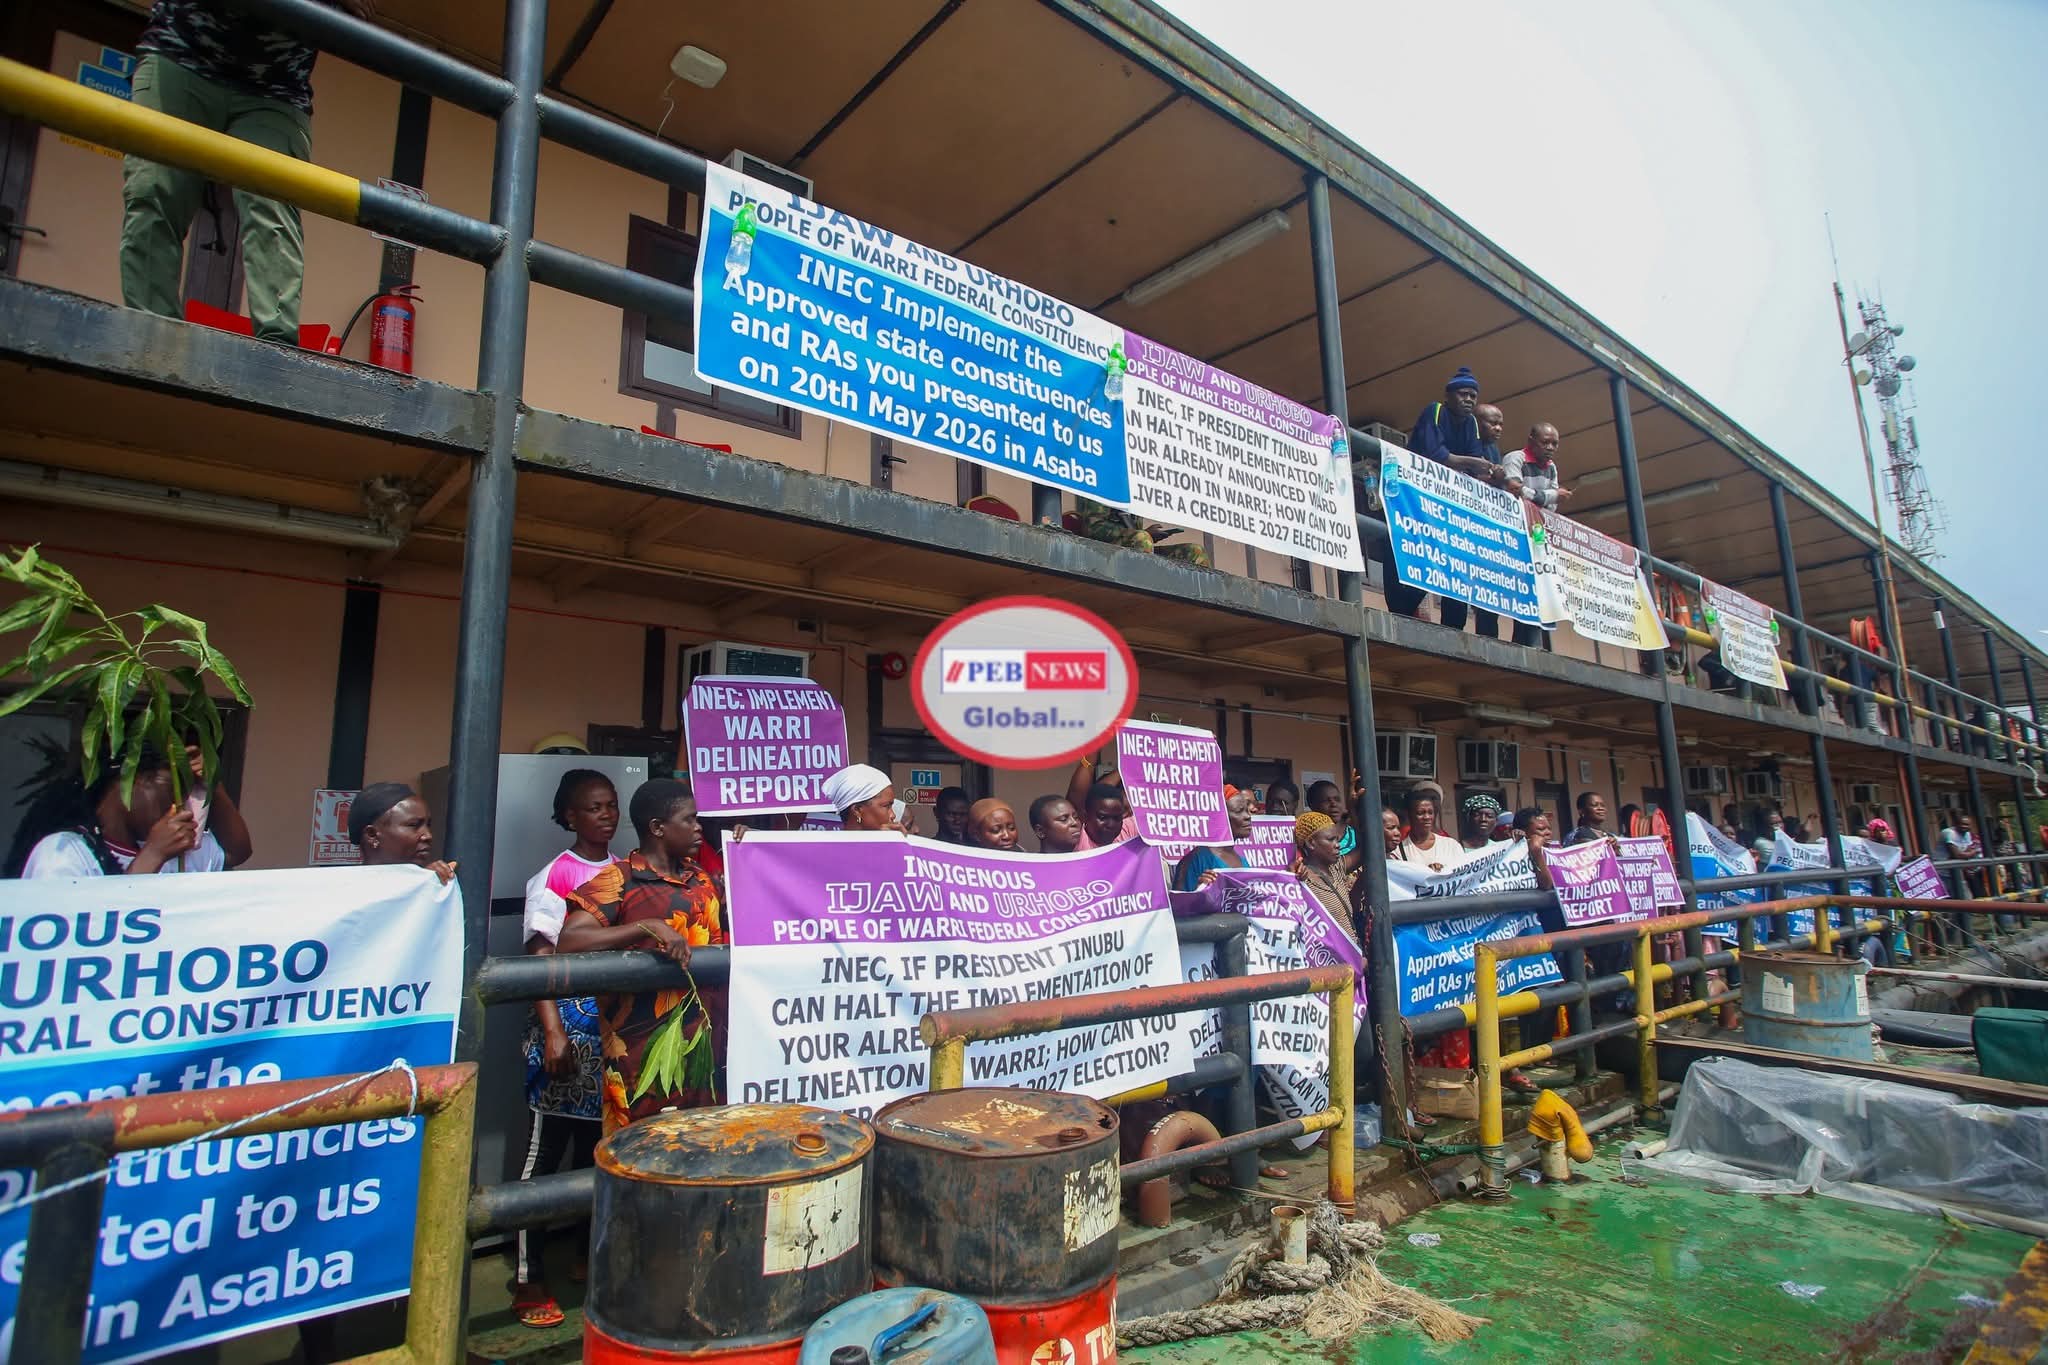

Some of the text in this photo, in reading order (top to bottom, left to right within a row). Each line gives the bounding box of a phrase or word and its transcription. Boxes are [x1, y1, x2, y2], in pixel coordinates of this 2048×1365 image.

[84, 76, 132, 100] Senior
[817, 226, 845, 250] OF
[851, 238, 919, 281] WARRI
[924, 268, 997, 315] FEDERAL
[905, 242, 957, 272] AND
[965, 263, 1075, 327] URHOBO
[796, 253, 1063, 377] INEC Implement the
[723, 270, 1112, 430] Approved state constituencies
[730, 310, 1105, 457] and RAs you presented to us
[1141, 340, 1313, 428] IJAW AND URHOBO
[1161, 373, 1177, 389] OF
[1178, 377, 1219, 407] WARRI
[1221, 394, 1267, 425] FEDERAL
[738, 354, 1099, 488] on 20th May 2026 in Asaba
[1137, 387, 1318, 467] INEC, IF PRESIDENT TINUBU
[1146, 414, 1335, 496] HALT THE IMPLEMENTATION OF
[1162, 443, 1224, 479] ALREADY
[1227, 466, 1306, 504] ANNOUNCED
[1308, 490, 1337, 515] WARD
[1410, 452, 1521, 515] IJAW AND URHOBO
[1421, 477, 1490, 519] OF WARRI FEDERAL
[1177, 496, 1348, 560] A CREDIBLE 2027 ELECTION?
[1204, 480, 1352, 541] IN WARRI; HOW CAN YOU
[1395, 510, 1449, 545] Approved
[1449, 533, 1477, 554] state
[1419, 495, 1519, 551] INEC Implement the
[1552, 534, 1561, 547] OF
[1575, 529, 1589, 544] AND
[1401, 538, 1424, 558] and
[1427, 545, 1447, 567] RAs
[1449, 555, 1467, 575] you
[1469, 562, 1516, 591] presented
[1517, 578, 1530, 595] to
[1407, 566, 1422, 581] on
[1425, 567, 1450, 591] 20th
[1451, 578, 1473, 602] May
[1474, 585, 1499, 606] 2026
[1500, 593, 1510, 609] in
[1593, 564, 1606, 583] The
[1599, 621, 1642, 645] Constituency
[691, 684, 837, 711] INEC: IMPLEMENT
[723, 715, 811, 741] WARRI
[1122, 732, 1218, 763] INEC: IMPLEMENT
[695, 743, 841, 773] DELINEATION
[918, 771, 934, 785] 01
[1142, 762, 1201, 786] WARRI
[719, 773, 824, 806] REPORT
[1127, 786, 1221, 812] DELINEATION
[1146, 812, 1210, 838] REPORT
[319, 843, 361, 853] FIRE
[1243, 847, 1289, 867] WARRI
[903, 855, 1036, 890] INDIGENOUS
[773, 891, 1153, 942] PEOPLE OF WARRI FEDERAL CONSTITUENCY
[826, 879, 1113, 919] IJAW AND URHOBO
[1564, 897, 1614, 920] REPORT
[821, 929, 1125, 988] INEC, IF PRESIDENT TINUBU
[1262, 928, 1283, 948] IF
[2, 938, 329, 1009] URHOBO
[772, 995, 826, 1026] CAN
[833, 992, 903, 1021] HALT
[909, 989, 960, 1016] THE
[1133, 953, 1153, 976] OF
[1411, 972, 1462, 1004] and RAs
[1506, 968, 1517, 988] in
[108, 980, 432, 1045] CONSTITUENCY
[744, 1062, 925, 1105] DELINEATION
[970, 1044, 1052, 1082] WARRI;
[1056, 1028, 1098, 1062] HOW
[1101, 1021, 1134, 1047] CAN
[1139, 1014, 1176, 1038] YOU
[779, 1027, 931, 1066] YOUR ALRE
[1257, 1029, 1270, 1050] A
[1073, 1041, 1170, 1087] ELECTION?
[1287, 1069, 1314, 1101] CAN
[236, 1176, 381, 1239] to us
[82, 1247, 355, 1350] in Asaba
